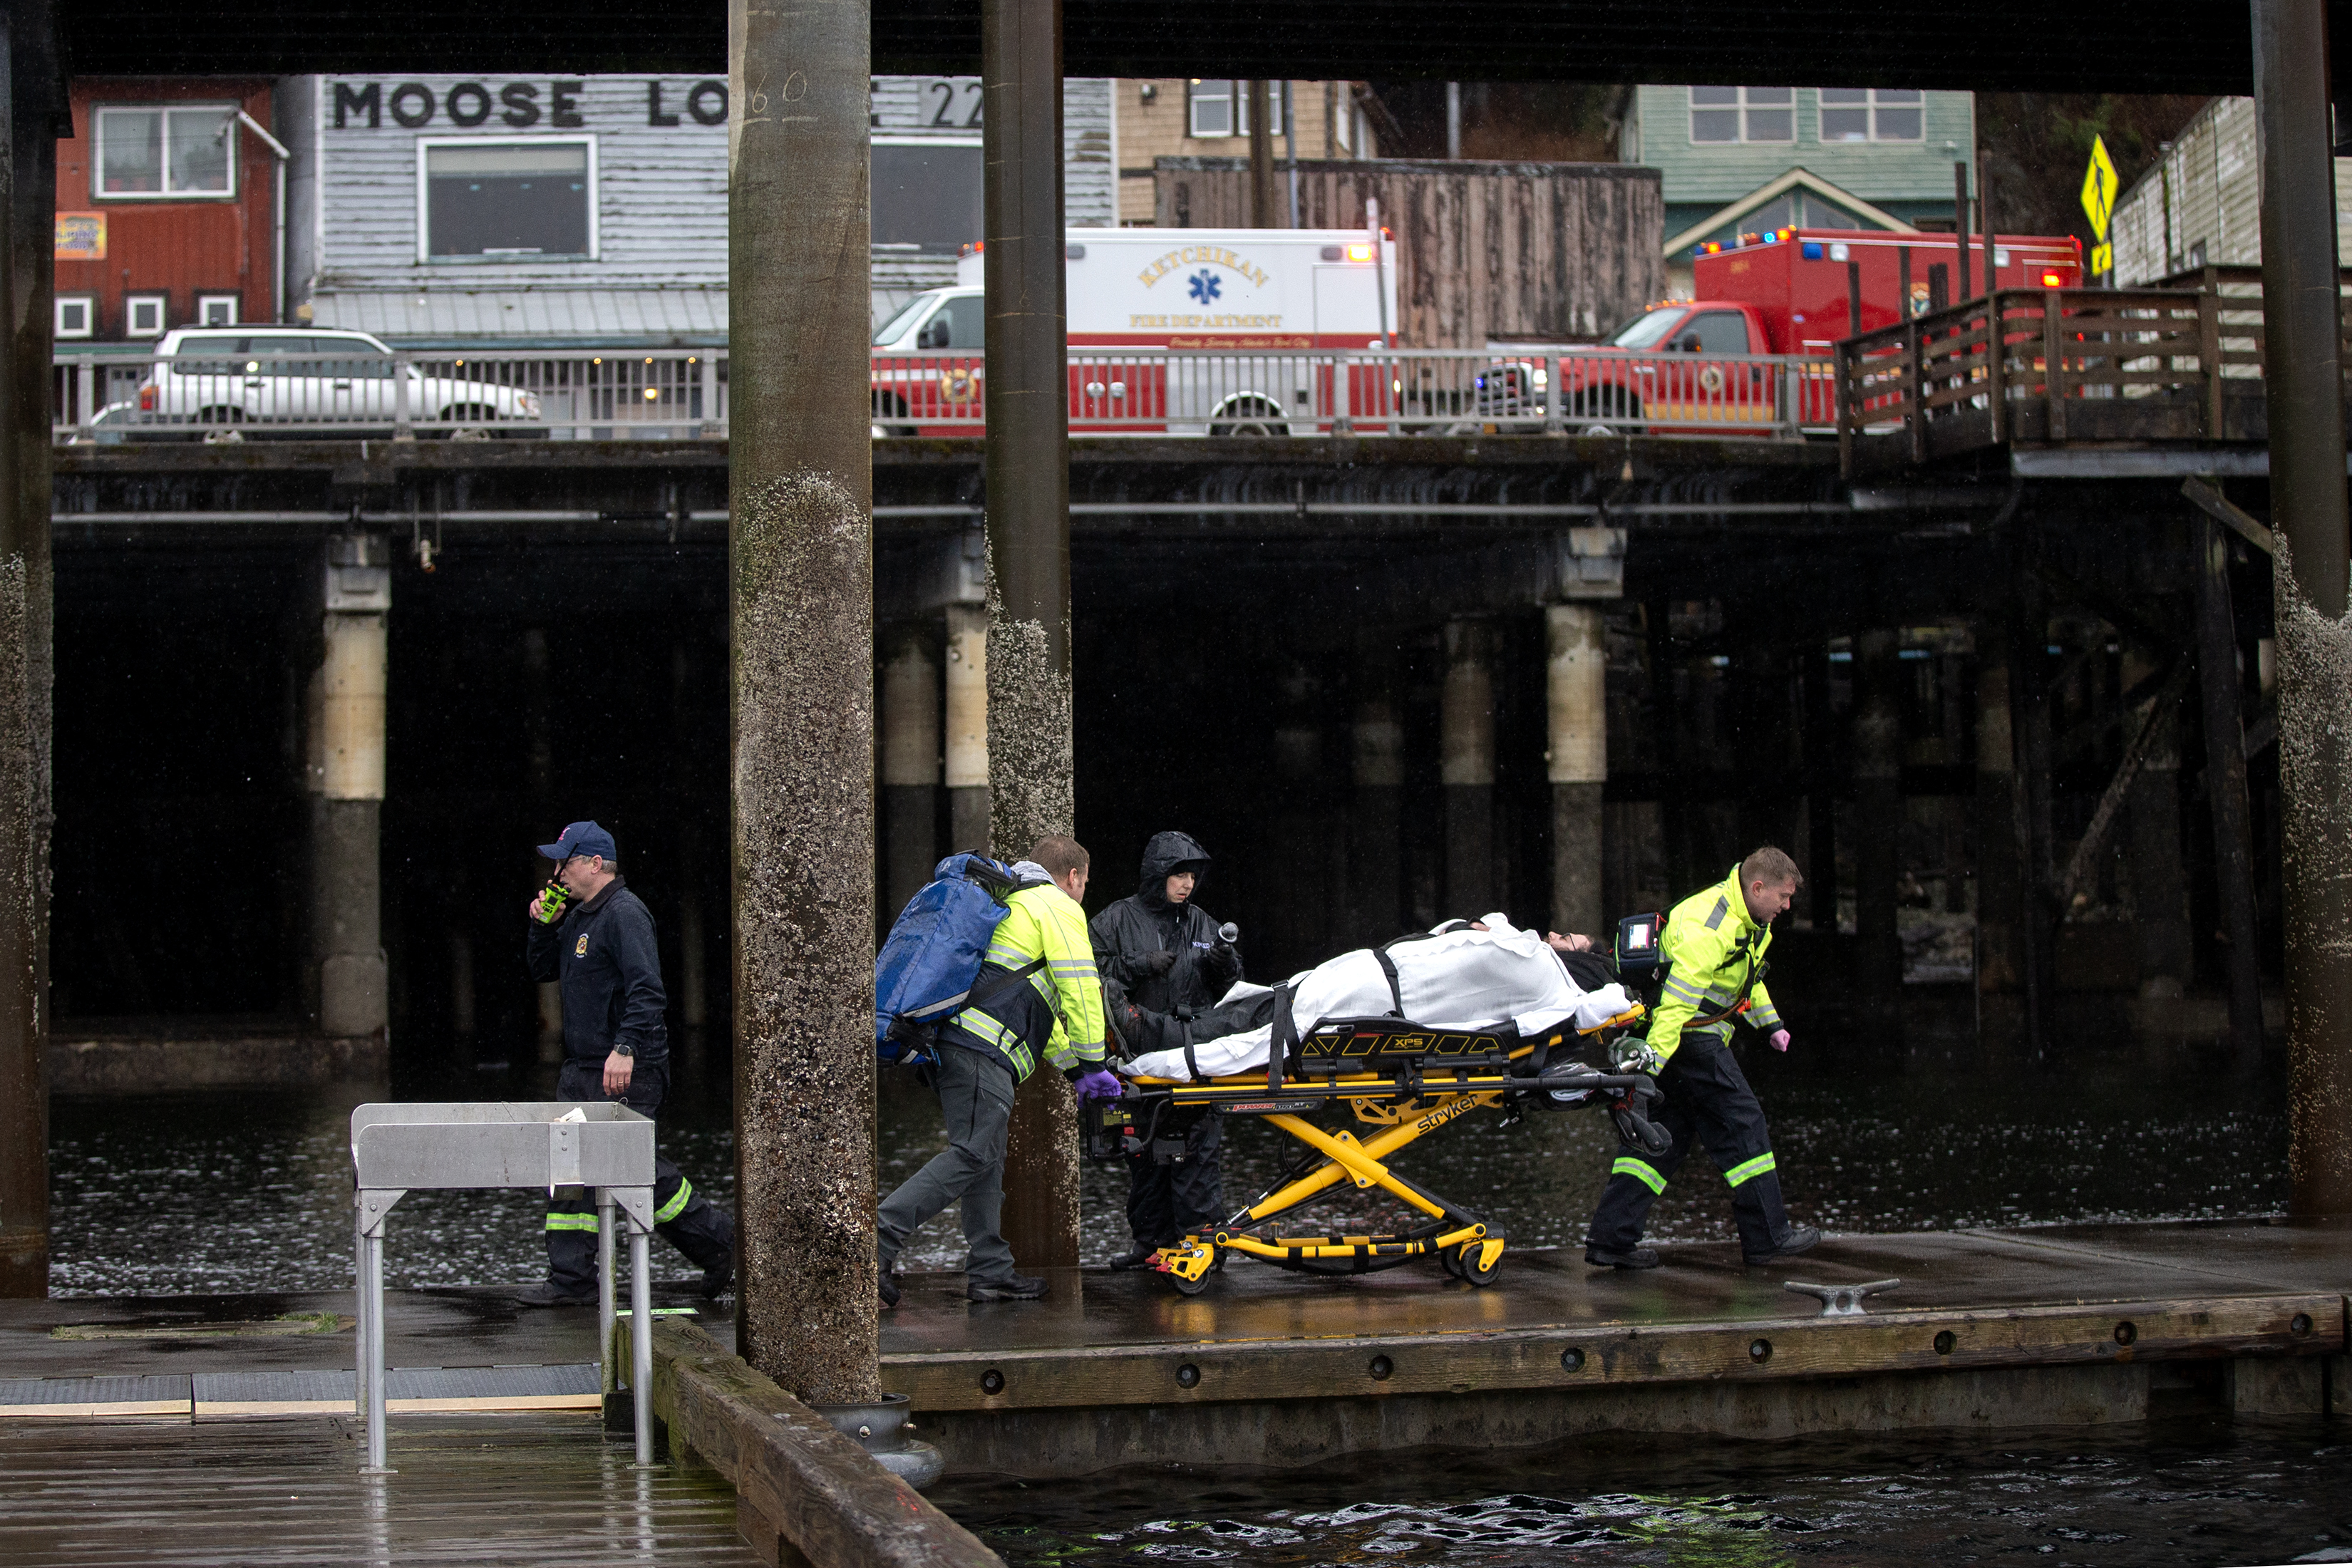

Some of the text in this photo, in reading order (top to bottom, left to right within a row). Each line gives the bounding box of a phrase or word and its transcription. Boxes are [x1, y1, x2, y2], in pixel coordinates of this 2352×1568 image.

[334, 82, 584, 128] MOOSE
[1138, 246, 1269, 289] KETCHIKAN
[1130, 314, 1282, 328] FIRE DEPARTMENT
[1395, 1038, 1423, 1048] XPS
[1417, 1094, 1478, 1135] stryker
